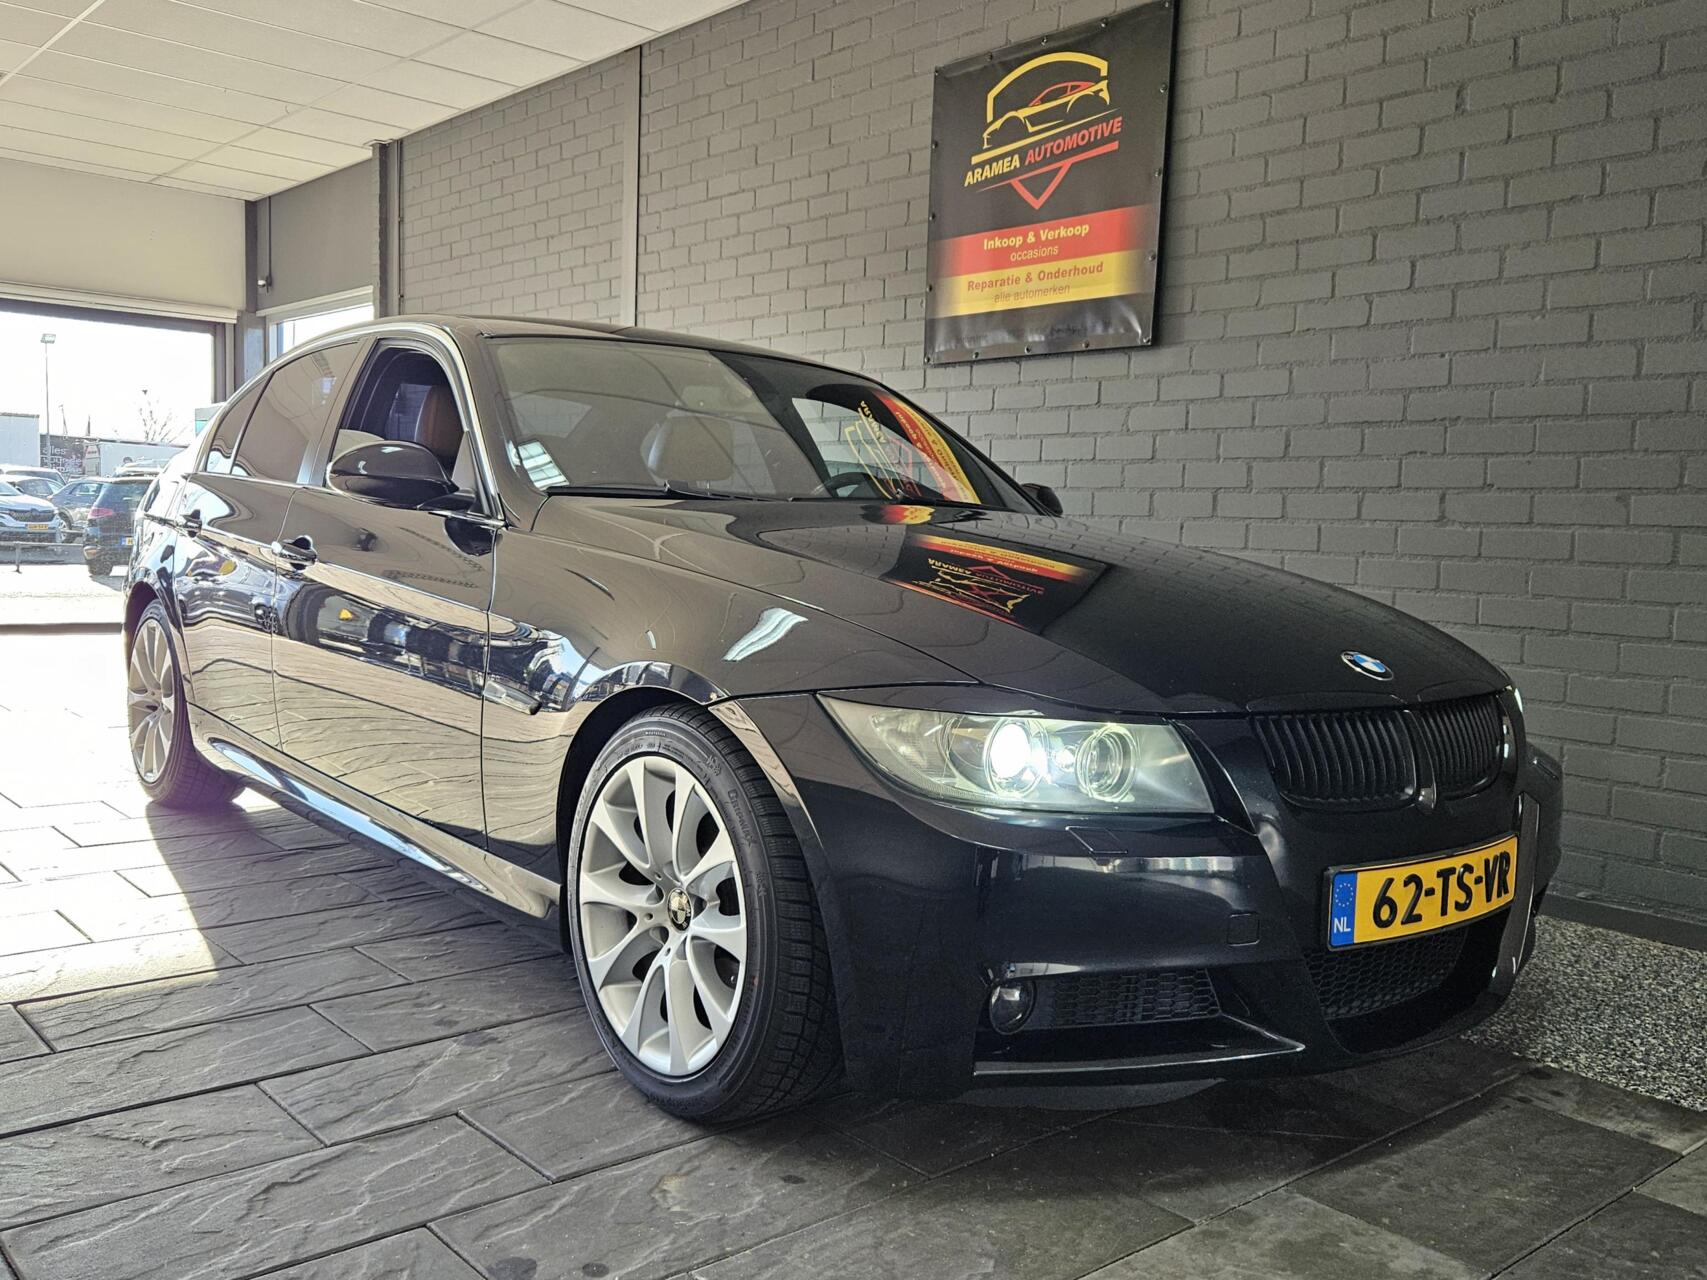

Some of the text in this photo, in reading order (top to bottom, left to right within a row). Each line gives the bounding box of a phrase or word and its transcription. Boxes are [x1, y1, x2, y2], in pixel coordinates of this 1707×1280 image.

[964, 116, 1123, 187] ARAMEA AUTOMOTIVE
[983, 224, 1090, 250] Inkoop & Verkoop
[1010, 246, 1058, 261] occasions
[967, 262, 1104, 292] Reparatie & Onderhoud
[993, 284, 1071, 303] alle automerken
[1373, 851, 1511, 929] 62-TS-VR
[1333, 916, 1351, 934] NL
